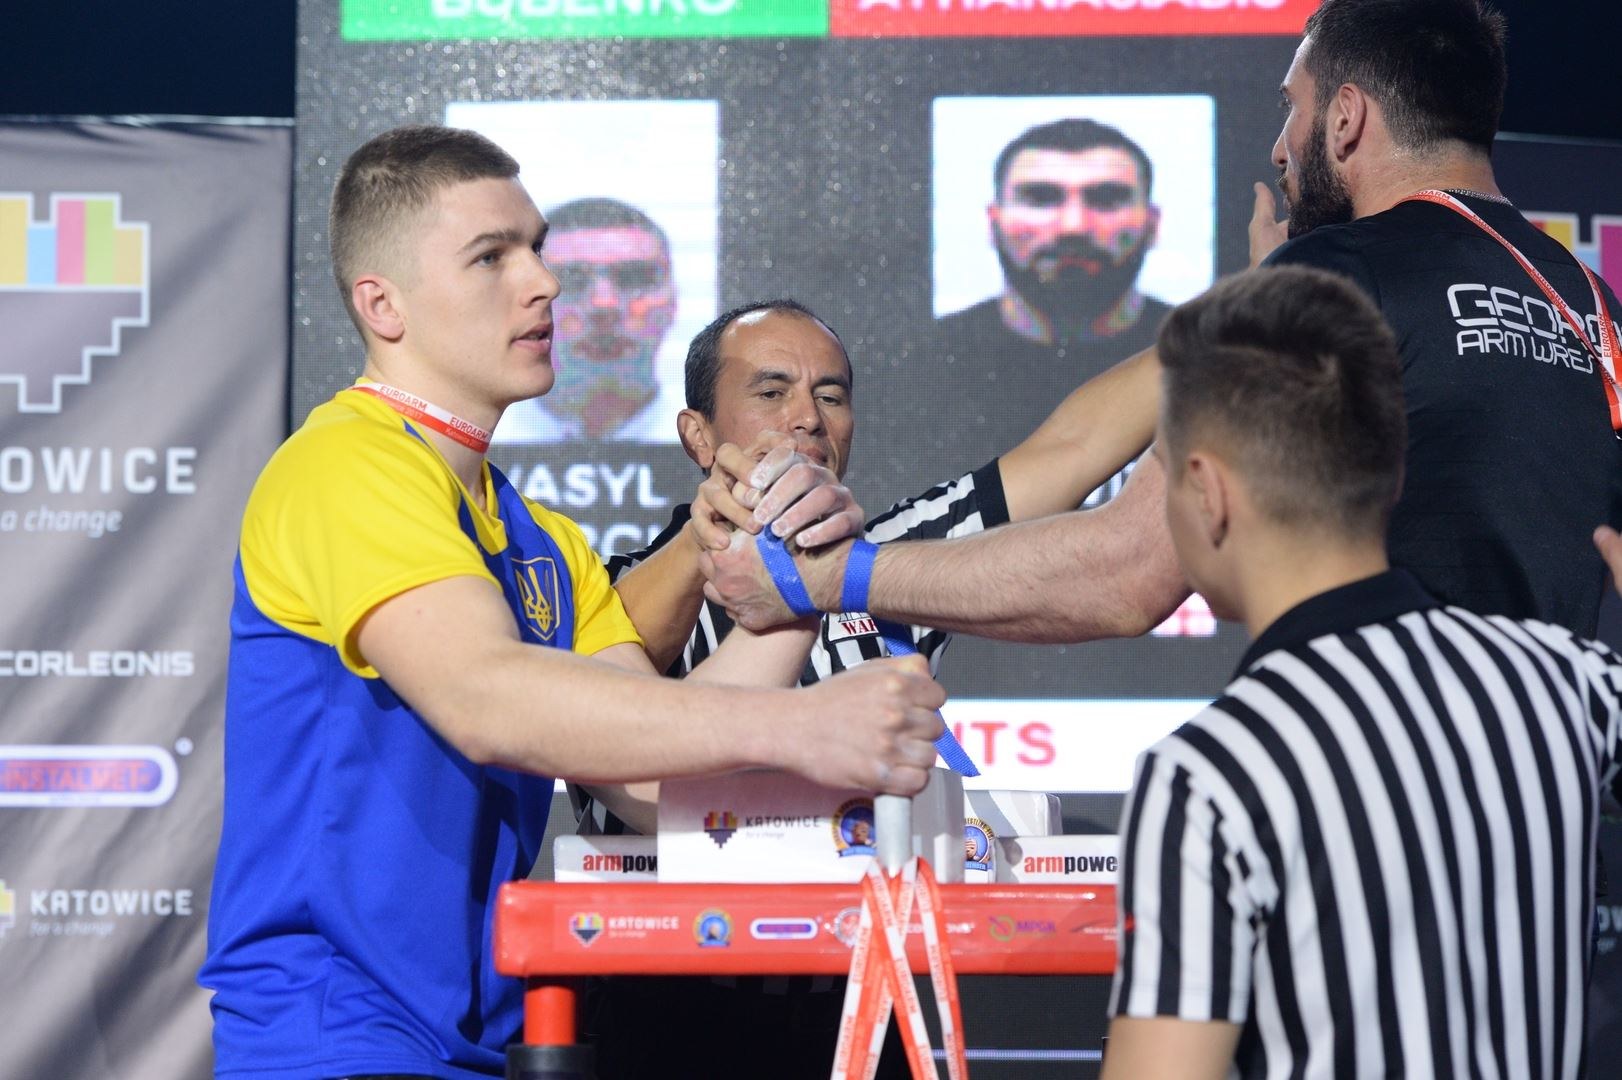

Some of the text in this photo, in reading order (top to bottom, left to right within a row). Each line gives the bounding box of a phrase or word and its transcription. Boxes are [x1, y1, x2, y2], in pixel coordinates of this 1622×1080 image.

[1446, 283, 1622, 353] GEOR
[1456, 328, 1527, 356] ARM
[1530, 335, 1597, 374] WRES
[379, 385, 428, 411] EUROARM
[450, 416, 489, 440] EUROARM
[0, 446, 197, 494] OWICE
[24, 505, 123, 538] change
[0, 650, 195, 677] CORLEONIS
[951, 720, 1057, 767] TS
[745, 815, 820, 828] KATOWICE
[583, 854, 658, 873] armpow
[1023, 855, 1118, 875] armpowe
[30, 889, 193, 916] KATOWICE
